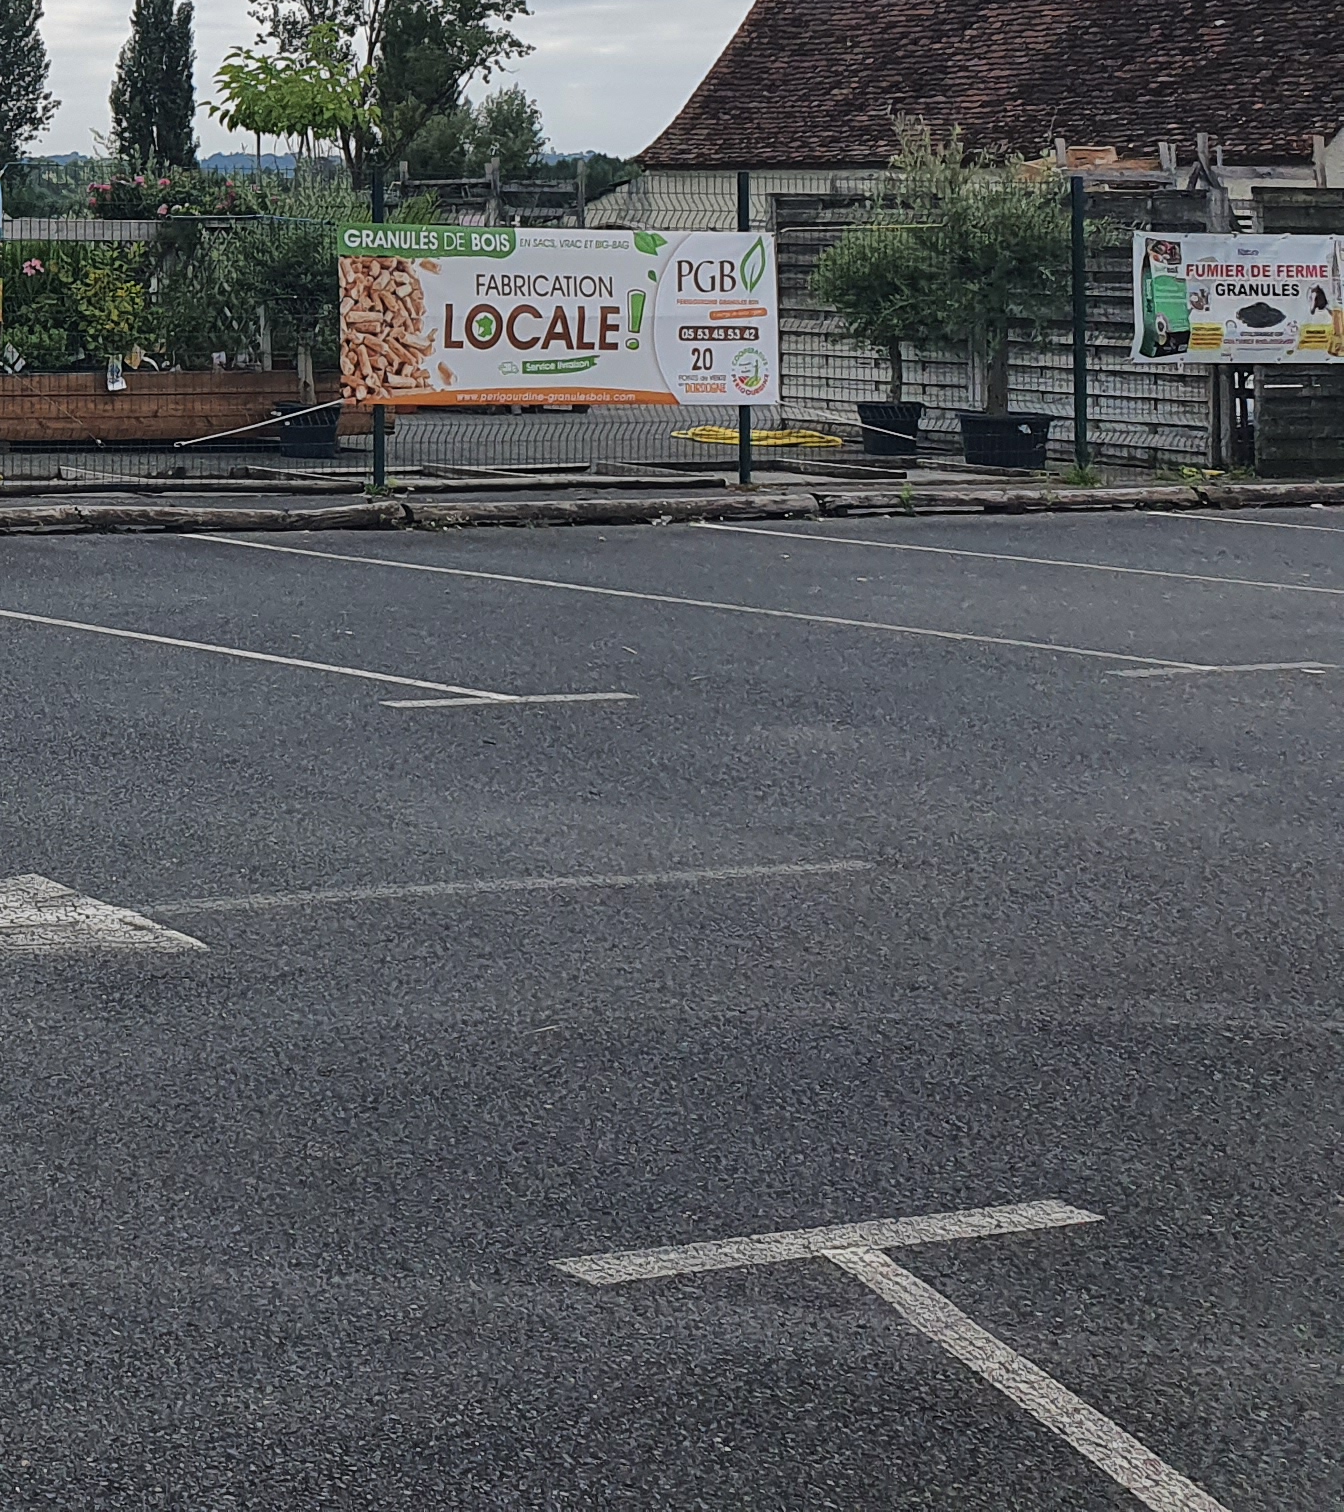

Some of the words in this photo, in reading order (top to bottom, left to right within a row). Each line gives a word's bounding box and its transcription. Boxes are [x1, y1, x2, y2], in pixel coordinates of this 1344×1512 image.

[343, 227, 438, 250] GRANULÉS
[443, 233, 466, 250] DE
[471, 233, 510, 252] BOIS
[520, 238, 531, 248] EN
[559, 239, 582, 249] VRAC
[676, 260, 736, 293] PGB
[1186, 264, 1245, 278] FUMIER
[1251, 264, 1273, 278] DE
[1276, 264, 1329, 278] FERME
[475, 273, 613, 298] FABRICATION
[1215, 280, 1299, 297] GRANULÉS
[681, 329, 694, 339] 05
[696, 329, 709, 339] 53
[712, 329, 724, 339] 45
[727, 329, 740, 339] 53
[743, 329, 755, 339] 42
[691, 347, 713, 371] 20
